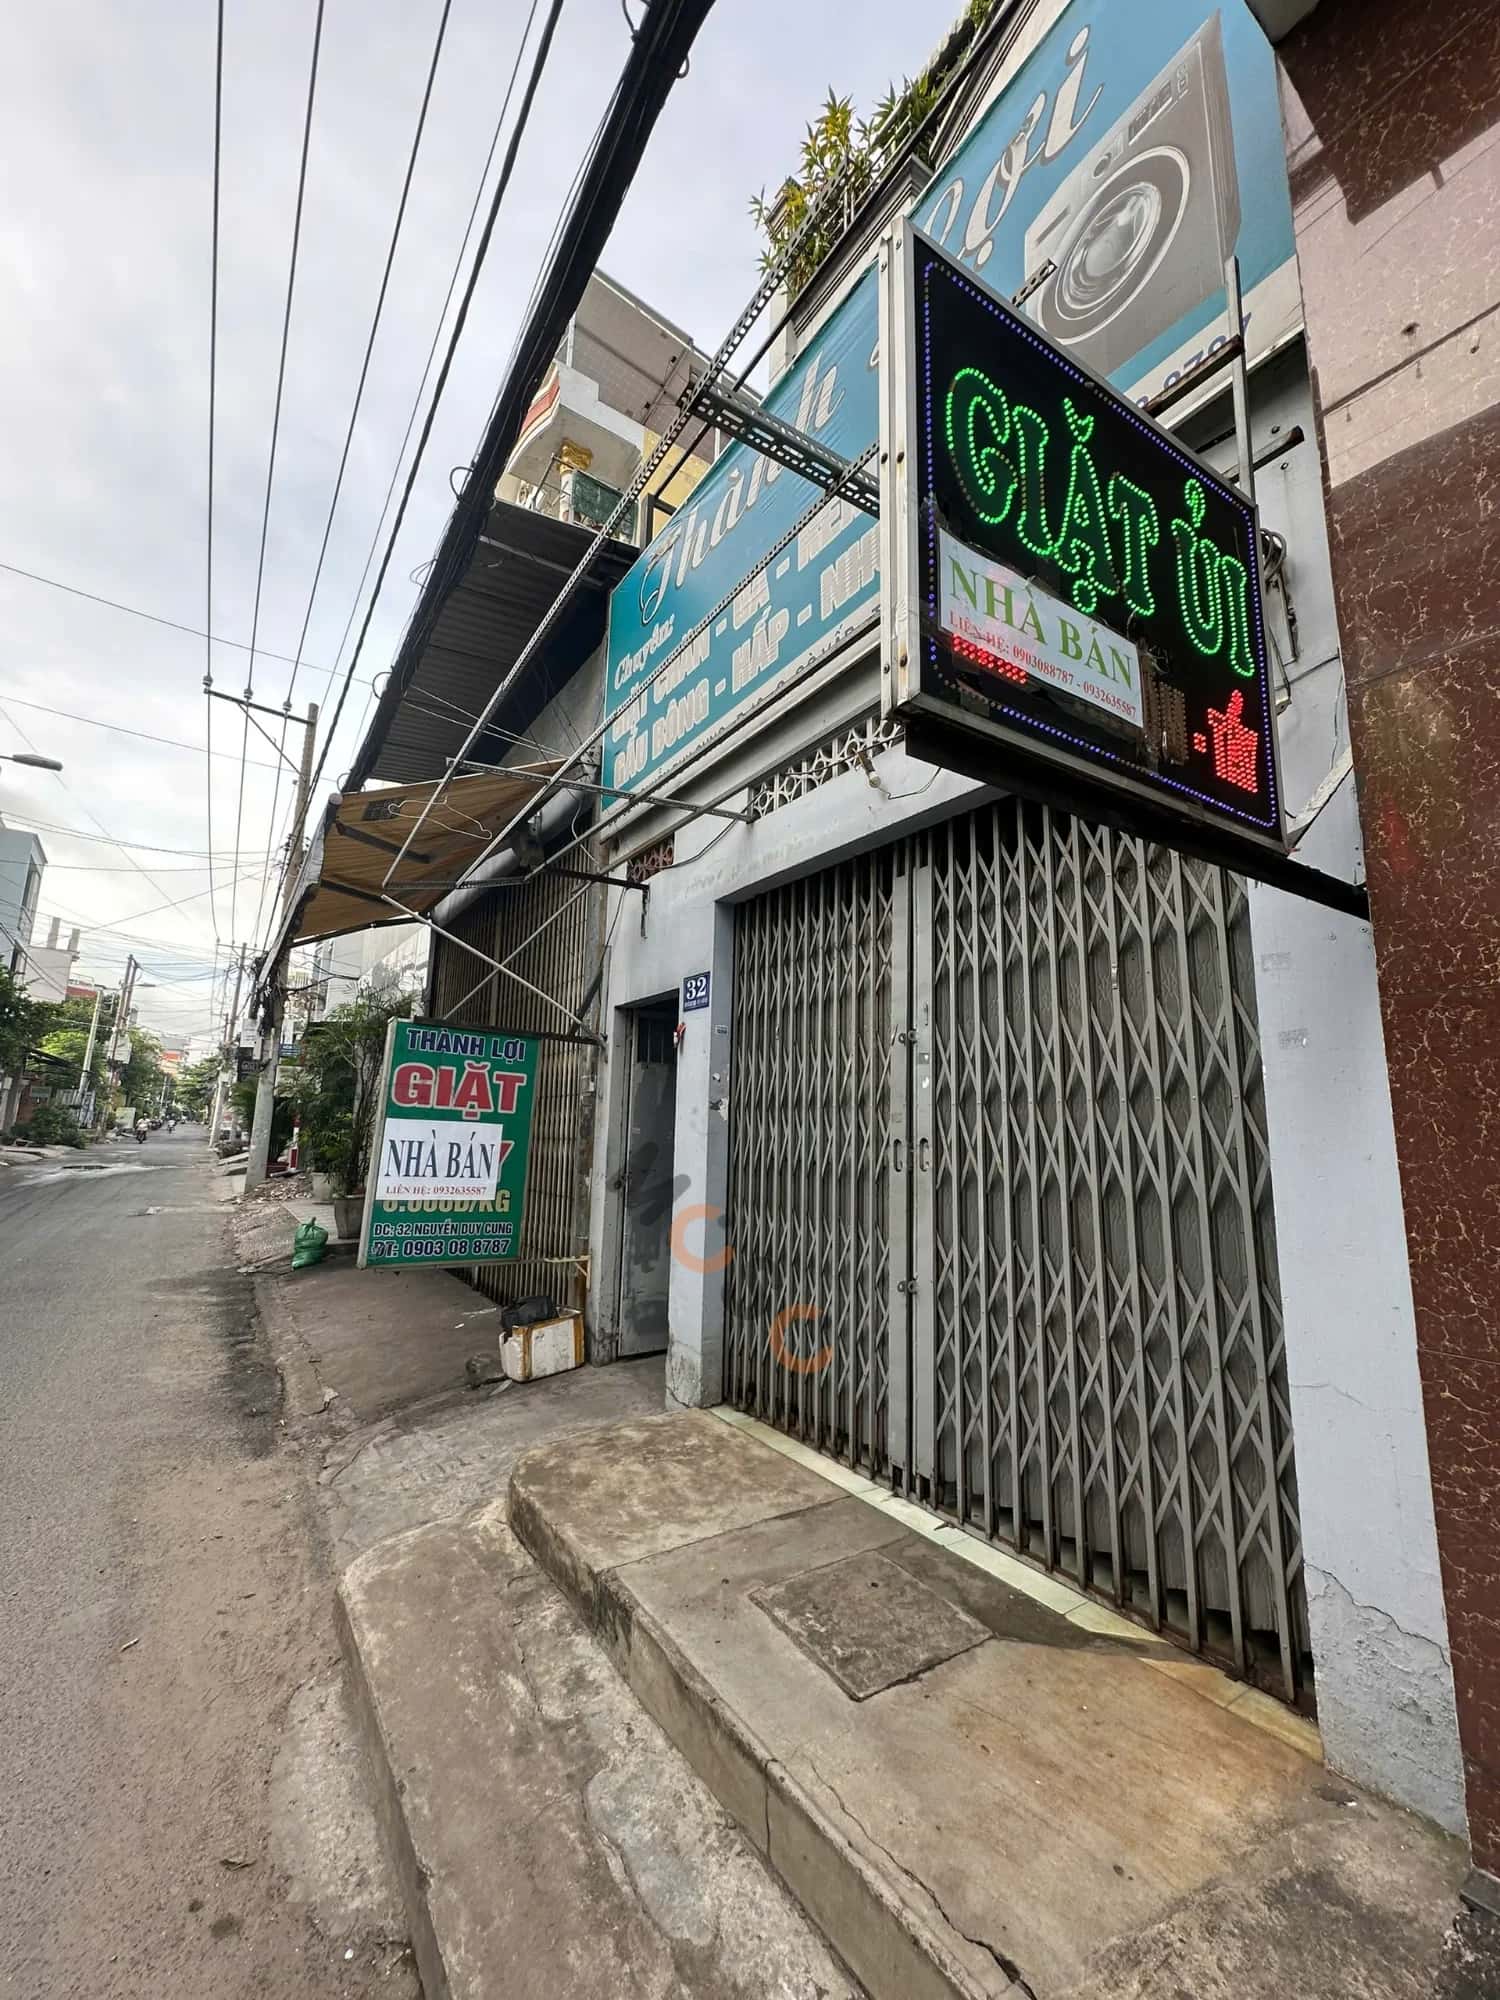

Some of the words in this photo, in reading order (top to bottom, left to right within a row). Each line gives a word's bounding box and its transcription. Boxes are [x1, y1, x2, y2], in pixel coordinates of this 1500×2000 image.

[640, 350, 845, 625] Thành
[945, 366, 1159, 616] GIẶT
[1170, 478, 1256, 678] ỦI
[614, 613, 675, 690] Chuyên:
[948, 555, 1049, 646] NHÀ
[1058, 616, 1132, 690] BÁN
[652, 678, 709, 760] BÔNG
[732, 605, 789, 694] HẤP
[1012, 645, 1074, 687] 0903088787
[1083, 681, 1137, 720] 0932635587
[686, 977, 707, 1000] 32
[407, 1028, 485, 1057] THÀNH
[491, 1038, 526, 1064] LỢI
[391, 1060, 527, 1120] GIẶT
[384, 1129, 438, 1178] NHÀ
[445, 1131, 495, 1179] BÁN
[386, 1184, 410, 1195] LIÊN
[412, 1185, 431, 1195] HỆ:
[433, 1186, 487, 1196] 0932635587
[373, 1223, 395, 1237] ĐC:
[396, 1223, 412, 1237] 32
[461, 1222, 482, 1236] DUY
[483, 1222, 513, 1236] CUNG
[403, 1239, 445, 1257] 0903
[448, 1239, 470, 1256] 08
[472, 1238, 511, 1256] 8787
